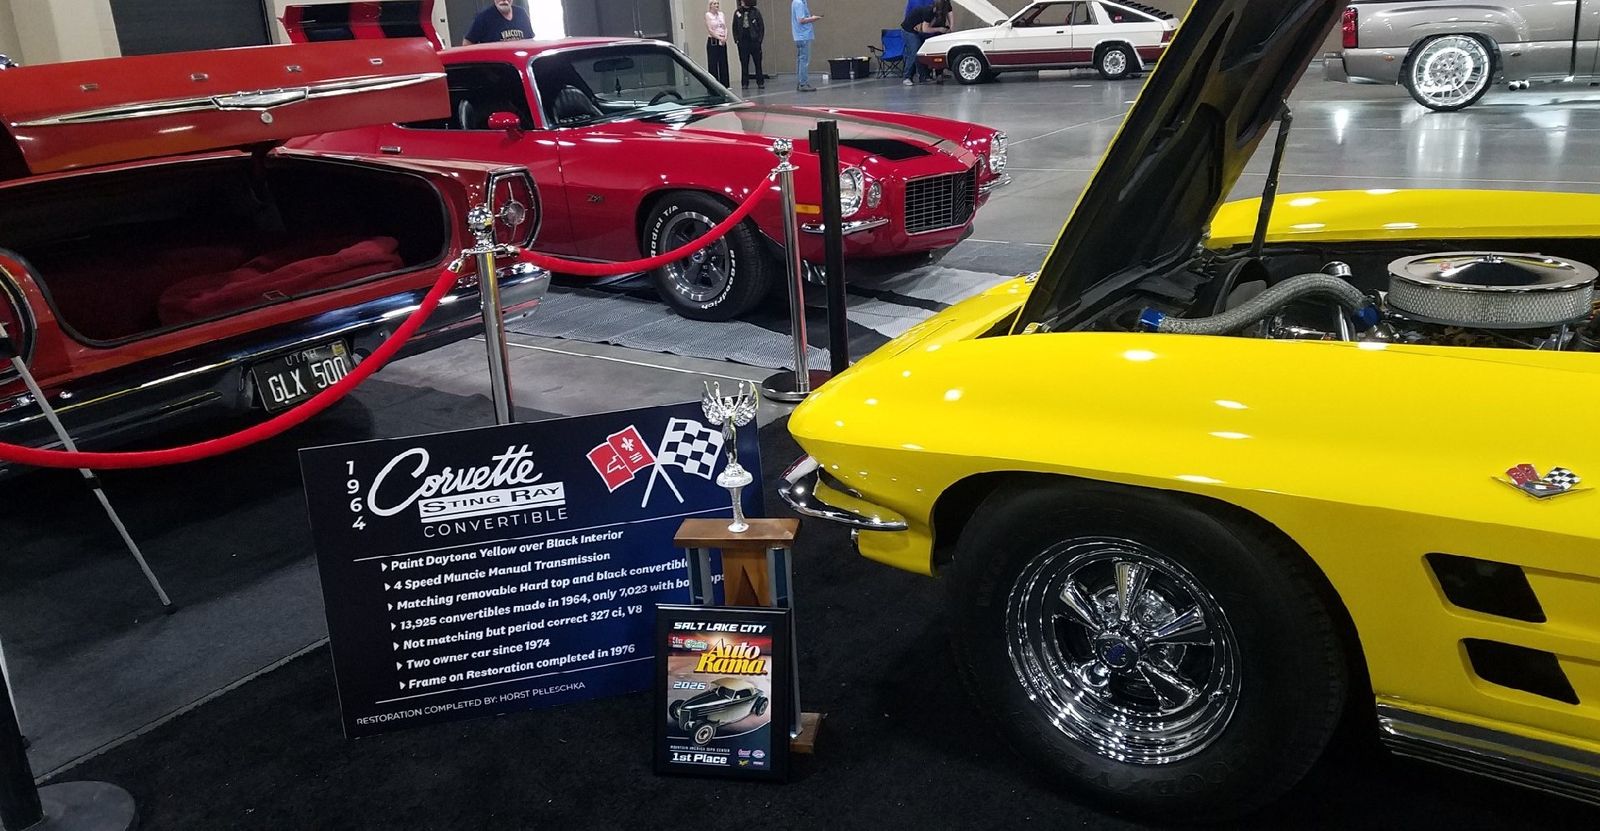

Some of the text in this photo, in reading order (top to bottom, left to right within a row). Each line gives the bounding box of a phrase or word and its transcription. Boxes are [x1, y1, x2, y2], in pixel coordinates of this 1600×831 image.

[285, 349, 320, 366] UTAH
[268, 356, 348, 402] GLX 500
[367, 444, 544, 517] Corvette
[423, 507, 568, 538] CONVERTIBLE
[391, 529, 624, 571] Paint Daytona Yellow over Black Interior
[393, 552, 611, 590] 4 Speed Muncie Manual Transmission
[396, 593, 454, 610] Matching
[456, 586, 517, 602] removable
[519, 578, 549, 592] Hard
[550, 577, 571, 589] top
[572, 572, 594, 585] and
[596, 567, 628, 581] black
[400, 616, 437, 631] 13,925
[439, 606, 511, 624] convertibles
[513, 601, 546, 614] made
[547, 598, 560, 608] in
[561, 593, 591, 607] 1964,
[592, 589, 618, 603] only
[619, 584, 648, 598] 7,023
[650, 578, 675, 592] with
[403, 604, 643, 650] Not matching but period correct 327 ci, V8
[673, 621, 767, 633] SALT LAKE CITY
[406, 638, 551, 670] Two owner car since 1974
[408, 643, 636, 690] Frame on Restoration completed in 1976
[694, 652, 766, 675] Rama
[706, 638, 761, 660] Auto
[356, 681, 586, 725] RESTORATION COMPLETED BY: HORST PELESCHKA
[673, 680, 707, 690] 2026
[672, 752, 692, 762] 1st
[693, 753, 728, 764] Place
